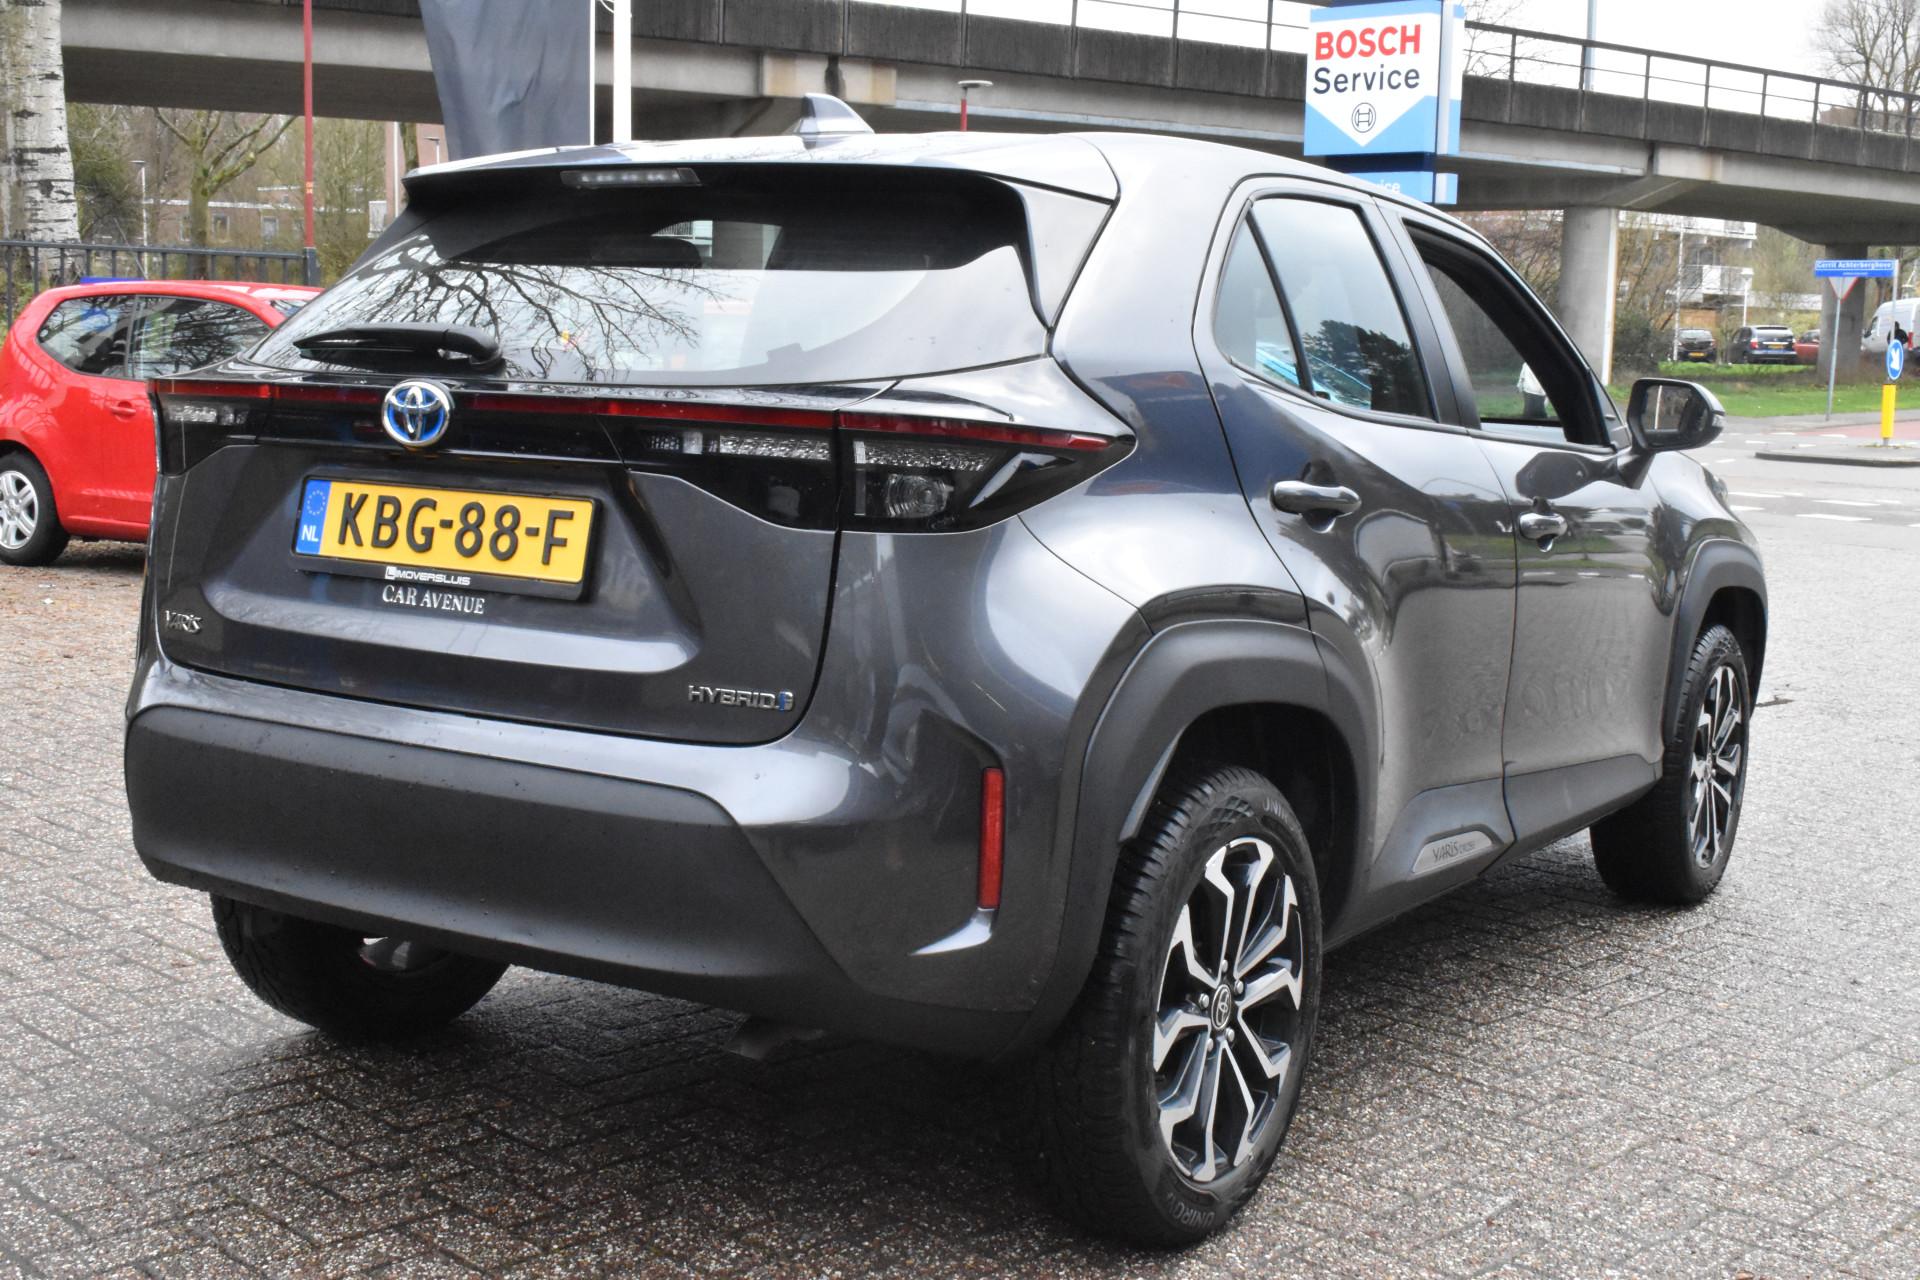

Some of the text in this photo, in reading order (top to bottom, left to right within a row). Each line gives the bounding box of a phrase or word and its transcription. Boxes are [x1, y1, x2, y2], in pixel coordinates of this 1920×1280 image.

[1315, 24, 1421, 60] BOSCH
[1313, 64, 1420, 94] Service
[301, 525, 319, 542] NL
[338, 492, 574, 565] KBG-88-F
[382, 584, 485, 614] CAR AVENUE
[688, 685, 776, 710] HYBRID
